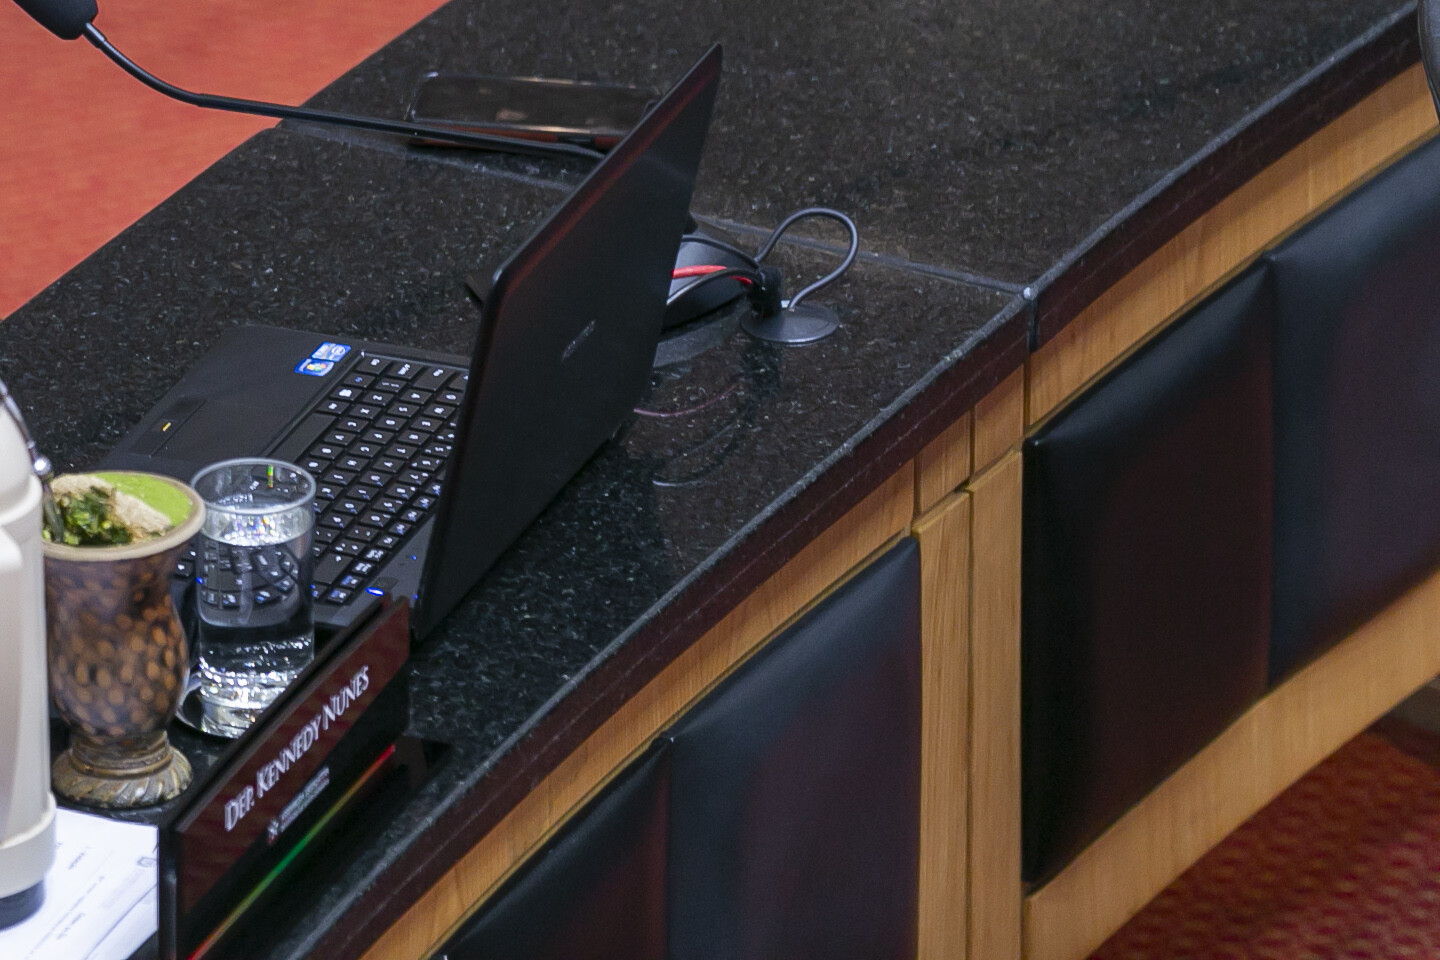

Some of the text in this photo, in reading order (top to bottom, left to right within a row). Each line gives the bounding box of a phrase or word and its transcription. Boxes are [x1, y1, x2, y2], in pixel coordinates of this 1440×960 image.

[225, 785, 255, 832] DEP.
[256, 713, 322, 799] KENNEDY
[322, 665, 370, 731] NUNES
